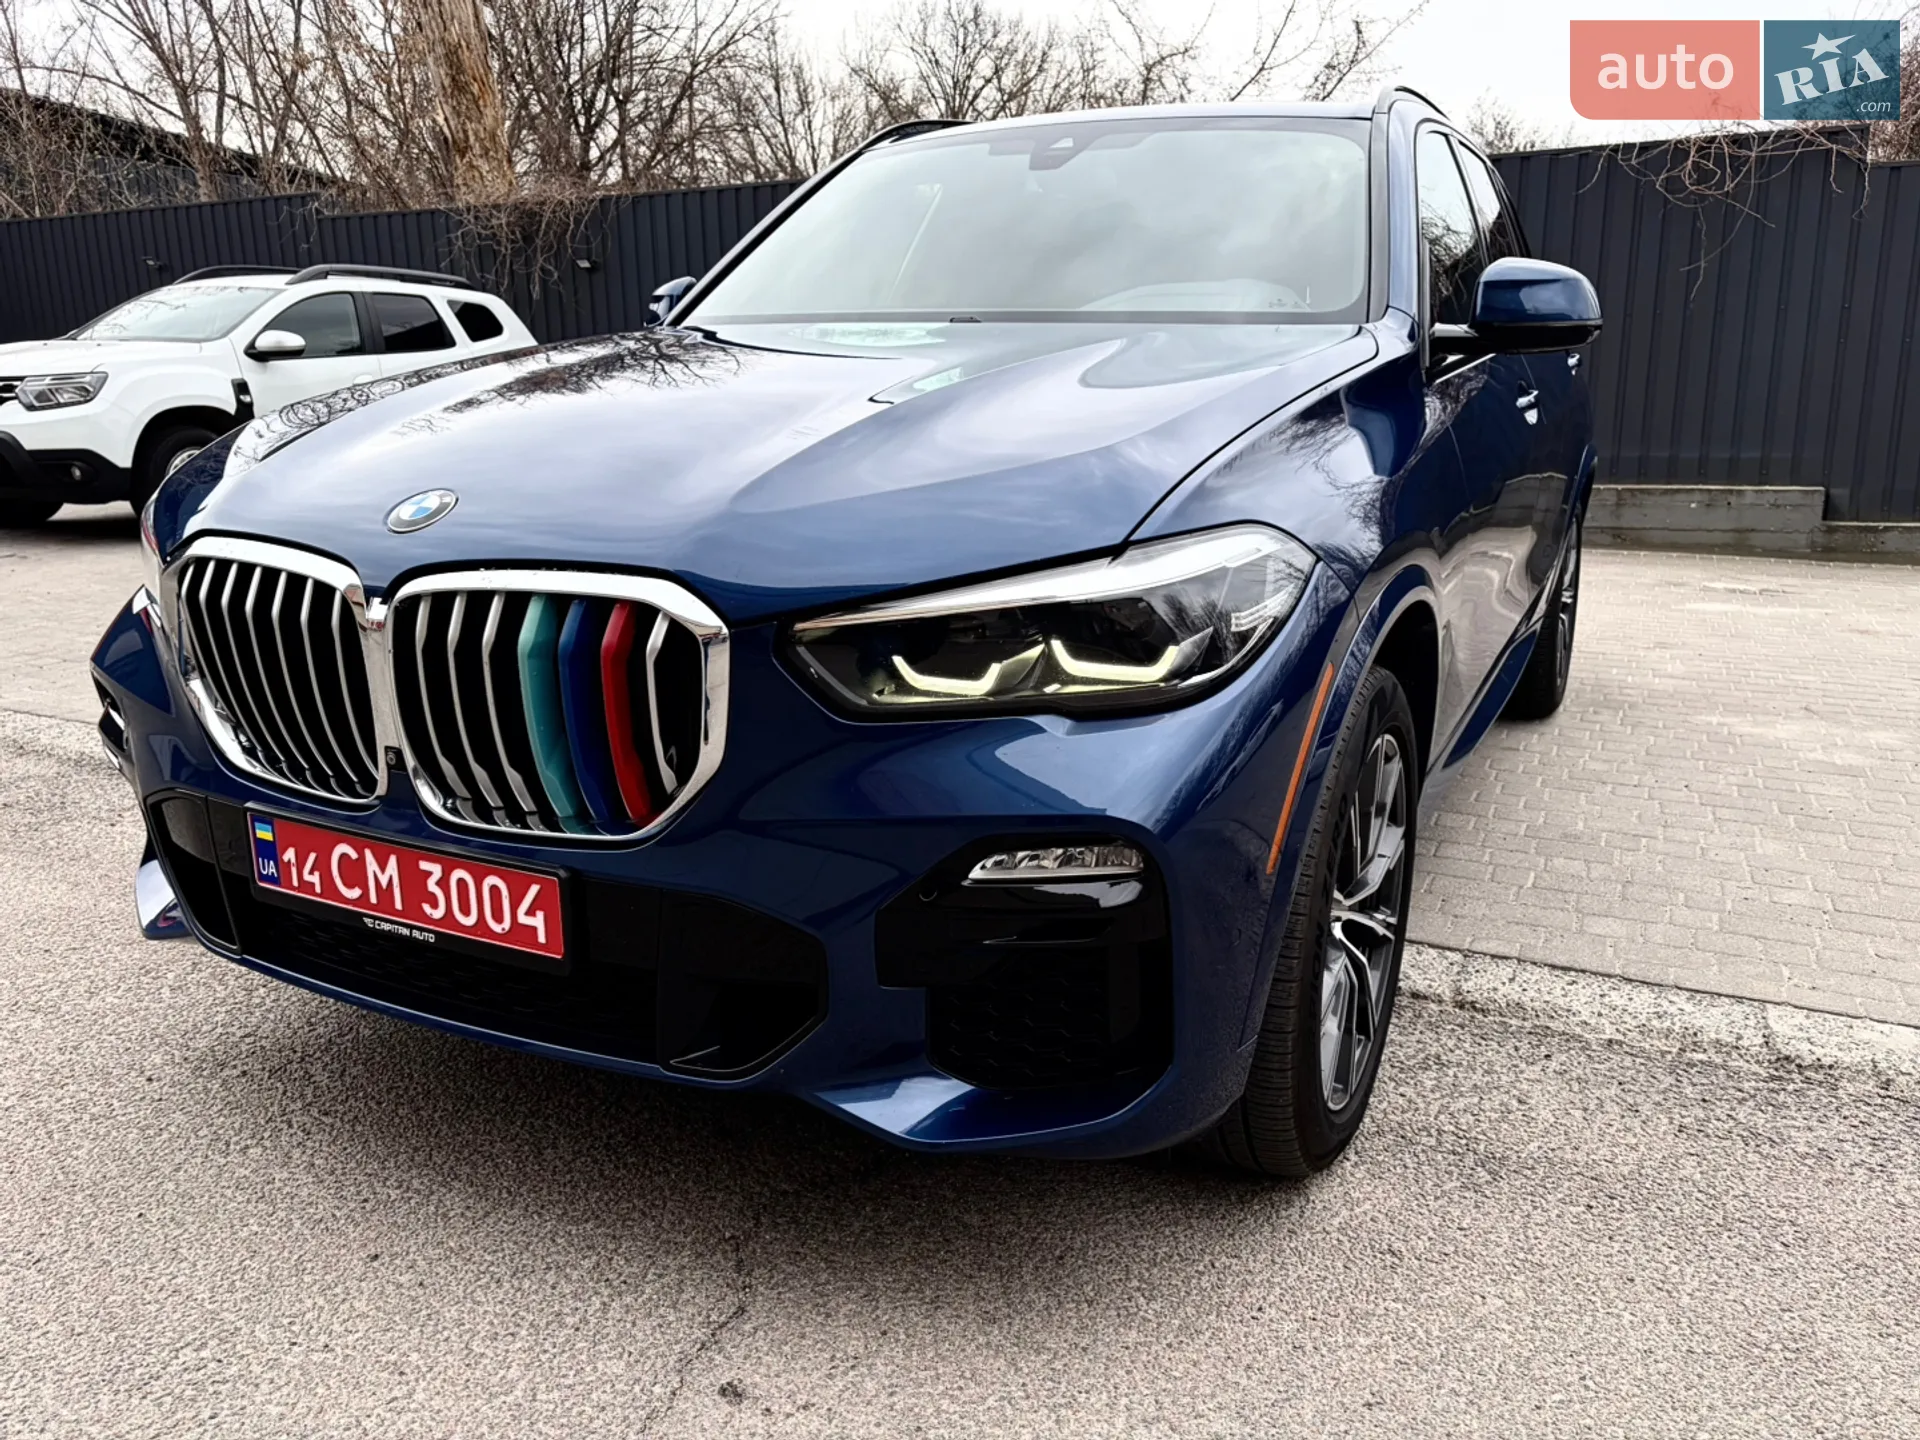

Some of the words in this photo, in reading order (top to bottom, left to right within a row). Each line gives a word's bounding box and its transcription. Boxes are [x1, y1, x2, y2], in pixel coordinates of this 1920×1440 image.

[259, 857, 278, 877] UA
[282, 847, 321, 894] 14
[331, 843, 403, 911] CM
[419, 860, 547, 944] 3004
[375, 920, 411, 937] CAPITAN
[412, 929, 435, 943] AUTO
